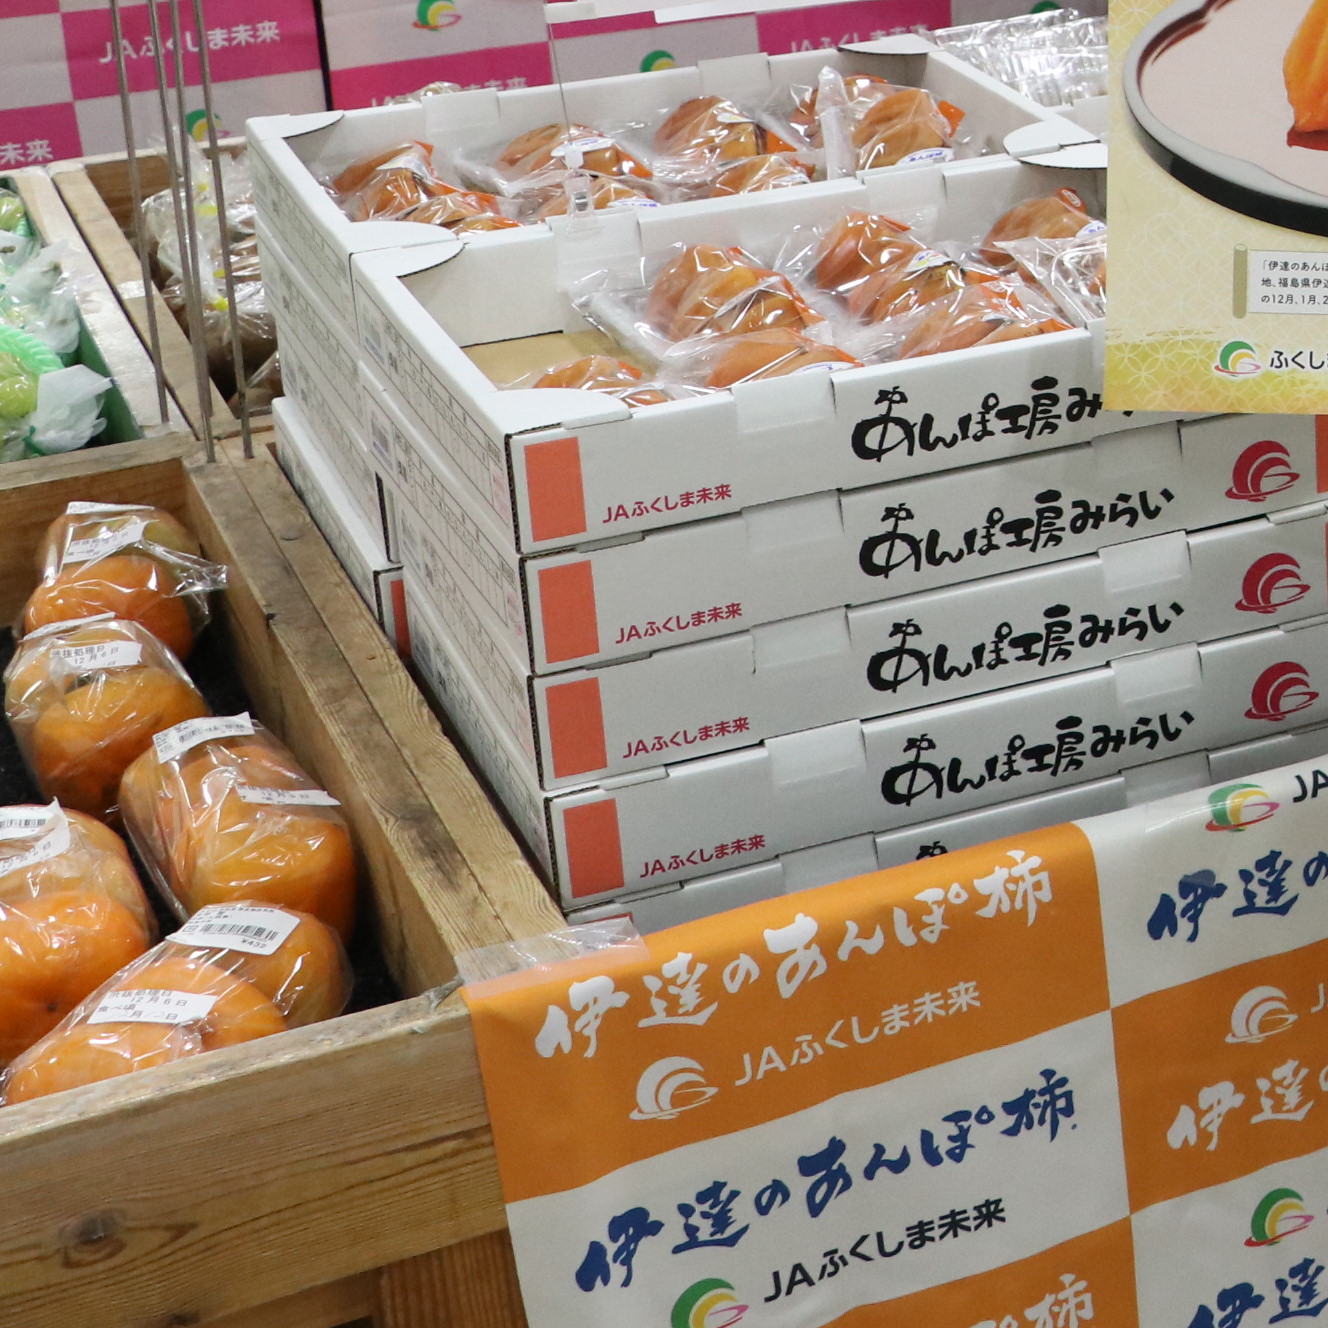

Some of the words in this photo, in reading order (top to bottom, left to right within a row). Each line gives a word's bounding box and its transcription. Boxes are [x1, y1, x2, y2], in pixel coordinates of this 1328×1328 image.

[850, 375, 1104, 462] あんぽ工房み
[602, 483, 733, 524] JAふくしま未来
[859, 486, 1175, 579] あんぽ工房みらい
[614, 602, 744, 645] JAふくしま未来
[867, 602, 1185, 693] あんぽ工房みらい
[622, 716, 751, 760] JAふくしま未来
[881, 713, 1194, 807] あんぽ工房みらい
[639, 834, 767, 880] JAふくしま未来
[534, 848, 1055, 1060] 伊達のあんぽ柿
[734, 980, 983, 1088] JAふくしま未来
[575, 1068, 1076, 1293] 伊達のあんぽ柿
[763, 1197, 1008, 1304] JAふくしま未来
